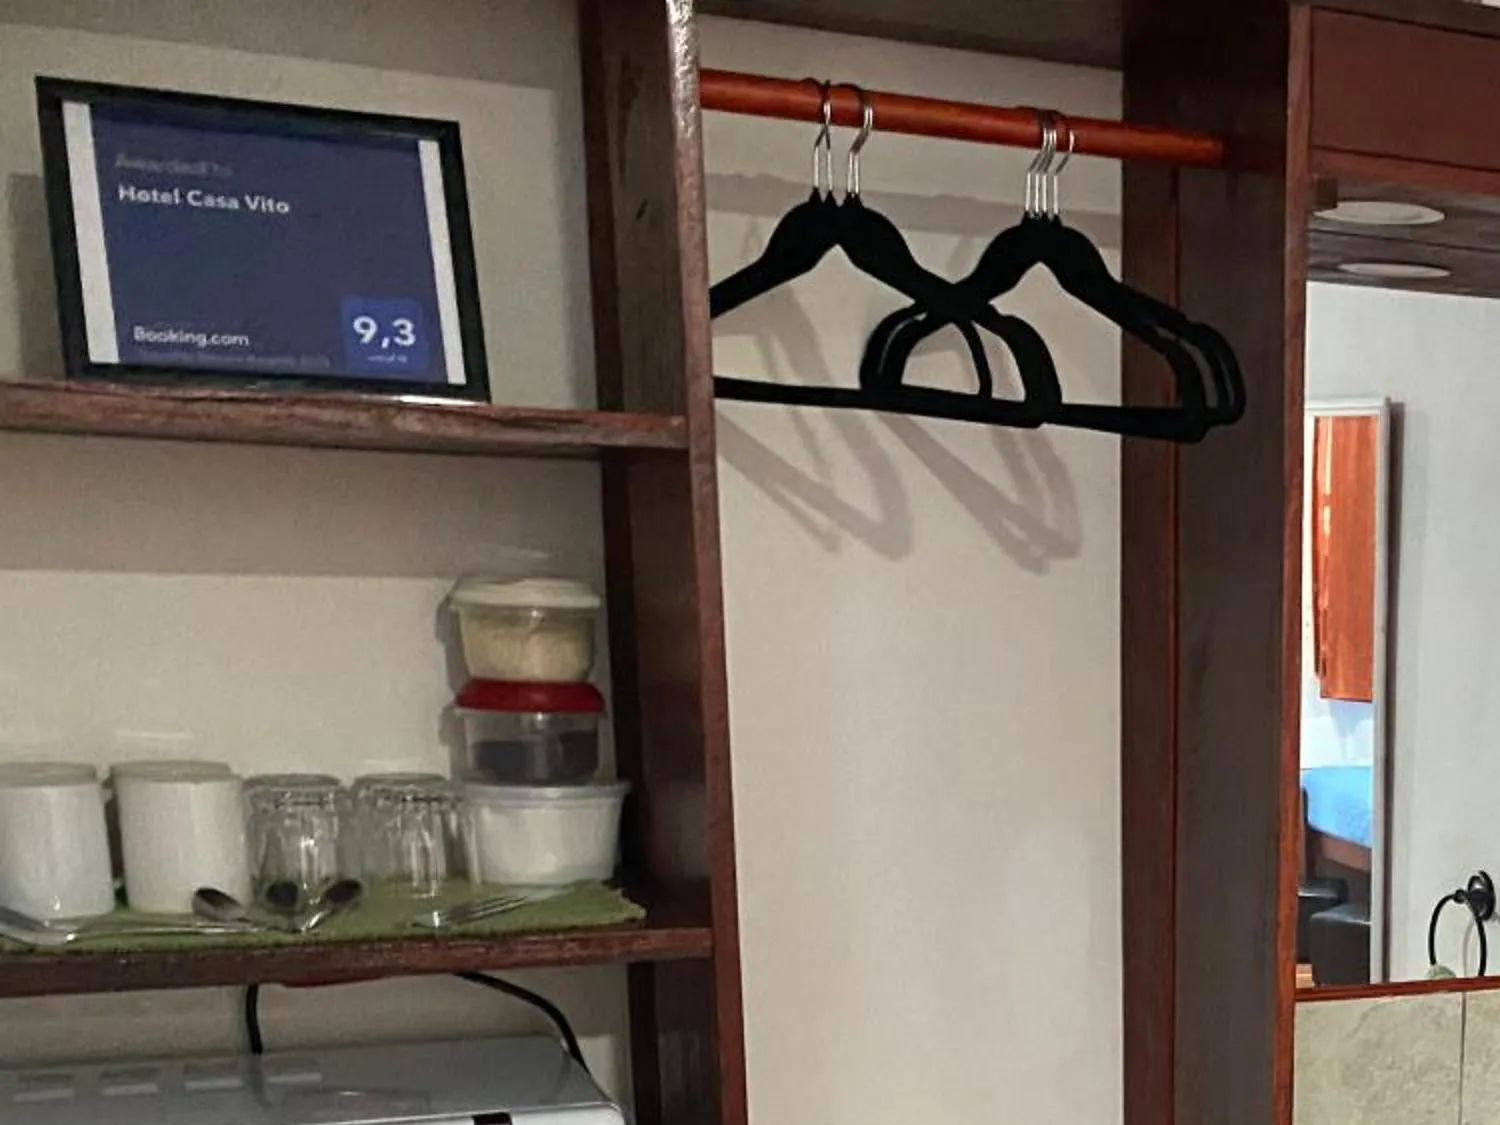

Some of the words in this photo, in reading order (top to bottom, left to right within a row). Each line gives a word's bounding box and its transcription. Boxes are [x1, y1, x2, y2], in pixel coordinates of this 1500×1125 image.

[118, 184, 180, 204] Hotel
[187, 189, 240, 209] Casa
[244, 194, 290, 214] Vito
[133, 325, 249, 348] Booking.com
[352, 315, 416, 348] 9,3
